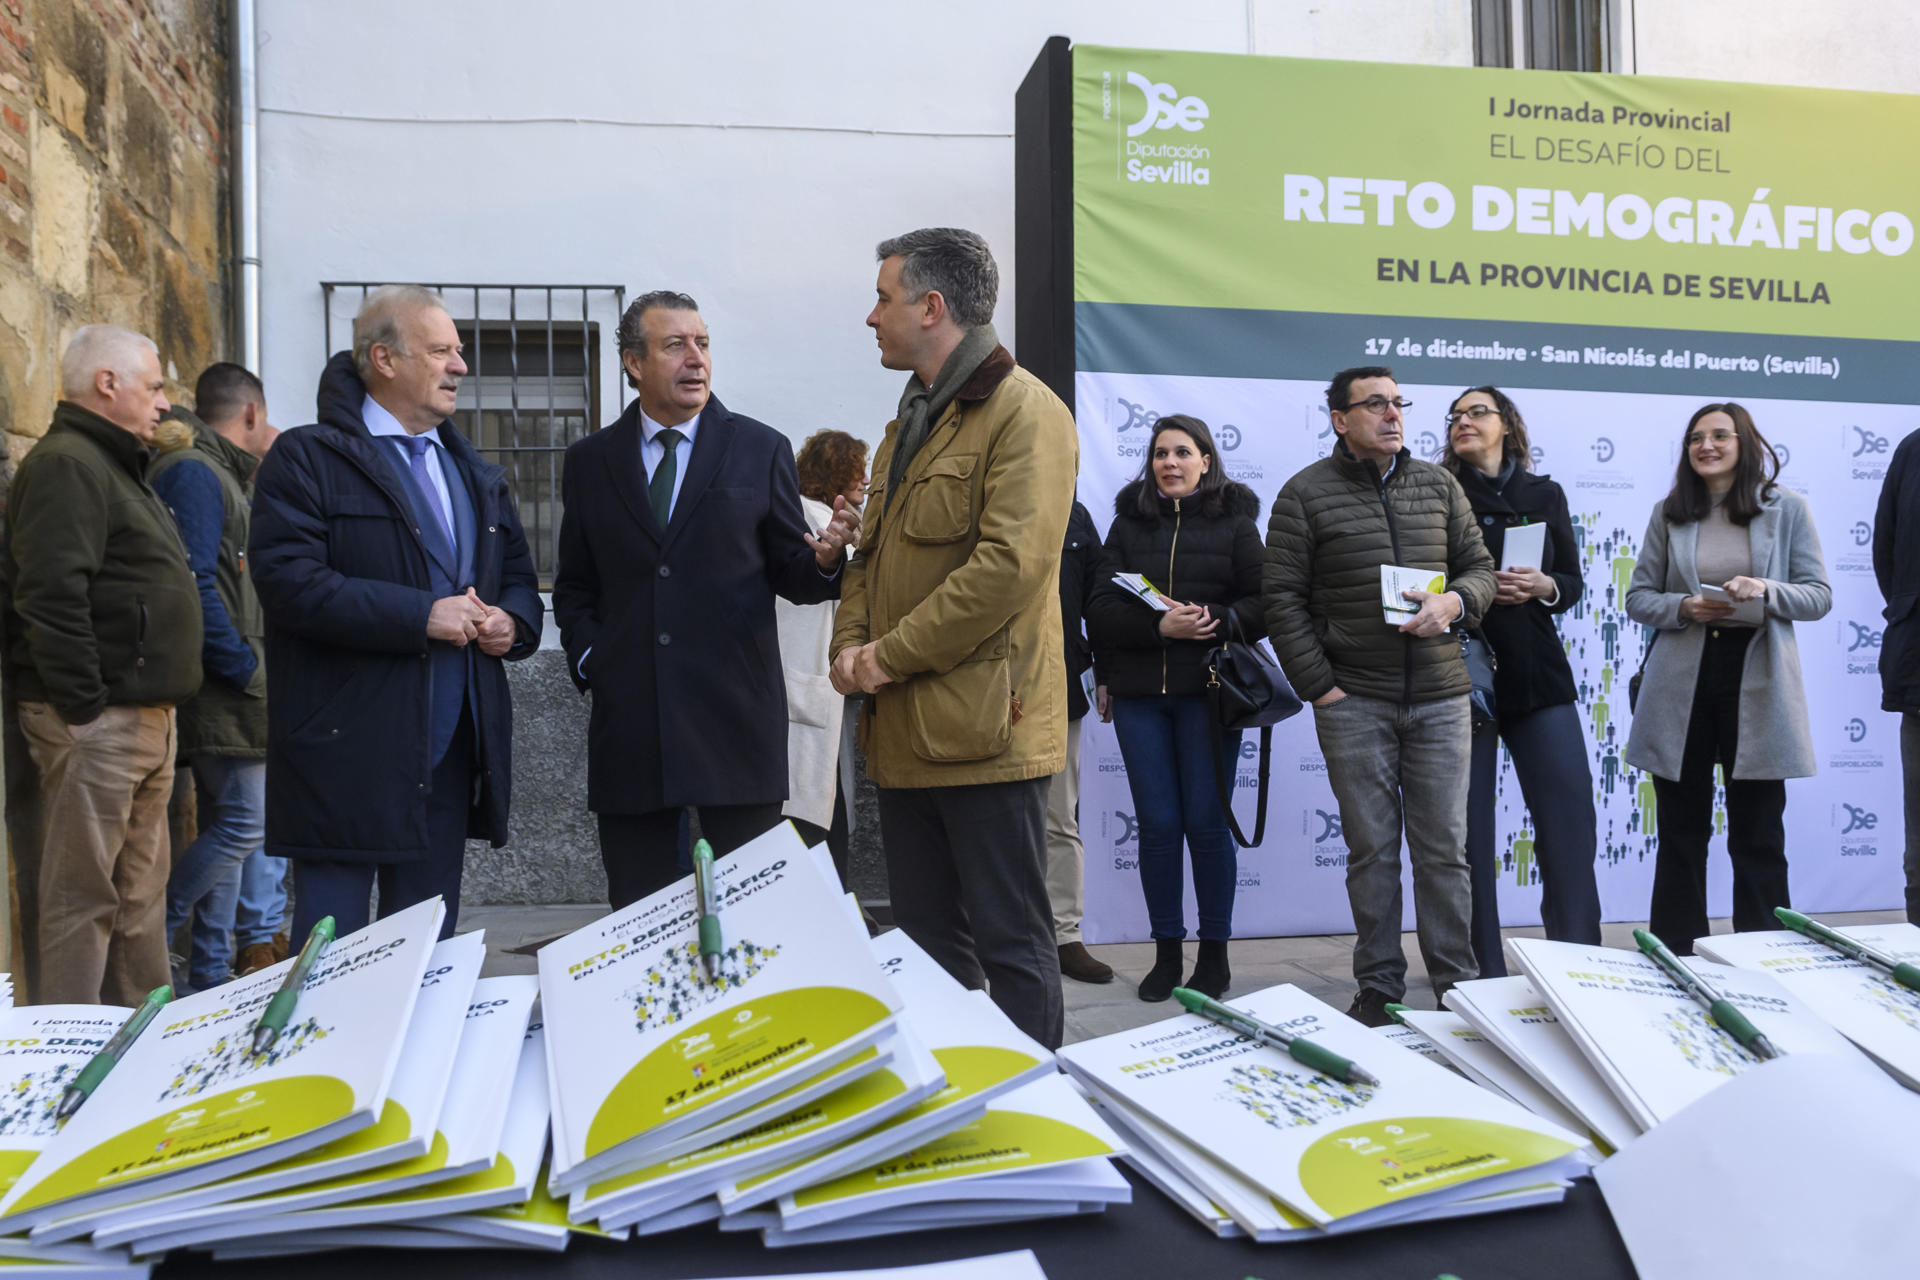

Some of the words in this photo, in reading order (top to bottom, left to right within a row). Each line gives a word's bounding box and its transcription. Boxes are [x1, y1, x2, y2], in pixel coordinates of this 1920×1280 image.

[1489, 97, 1495, 116] I
[1503, 98, 1604, 125] Jornada
[1612, 106, 1731, 133] Provincial
[1127, 140, 1210, 159] Diputación
[1490, 134, 1526, 159] EL
[1535, 136, 1666, 169] DESAFÍO
[1675, 146, 1731, 174] DEL
[1127, 158, 1210, 185] Sevilla
[1284, 173, 1456, 229] RETO
[1472, 185, 1915, 256] DEMOGRÁFICO
[1377, 257, 1419, 282] EN
[1429, 260, 1471, 285] LA
[1480, 262, 1654, 294] PROVINCIA
[1663, 273, 1701, 297] DE
[1709, 276, 1831, 304] SEVILLA
[1365, 337, 1393, 355] 17
[1396, 336, 1423, 357] de
[1426, 338, 1527, 362] diciembre
[1541, 345, 1580, 364] San
[1583, 346, 1657, 368] Nicolás
[1660, 349, 1690, 369] del
[1694, 353, 1760, 373] Puerto
[1763, 354, 1841, 380] (Sevilla)
[1835, 563, 1873, 572] DESPOBLA
[1848, 663, 1880, 675] Sevill
[1315, 855, 1349, 867] Sevill
[569, 943, 627, 974] RETO
[632, 859, 787, 946] DEMOÁFICO
[574, 968, 594, 981] EN
[598, 959, 617, 970] LA
[621, 918, 699, 960] PROVINCIA
[726, 873, 784, 907] SEVILLA
[610, 902, 667, 934] Jornada
[329, 951, 393, 981] SEVILLA
[1760, 956, 1811, 968] RETO
[1567, 971, 1625, 984] RETO
[42, 1018, 113, 1027] Jornada
[165, 1008, 230, 1032] RETO
[1508, 1006, 1550, 1017] RET
[1140, 1030, 1193, 1048] Jornada
[692, 1079, 715, 1093] de
[719, 1037, 807, 1082] diciembre
[1119, 1056, 1176, 1073] RETO
[1135, 1071, 1156, 1079] EN
[1157, 1066, 1177, 1074] LA
[1177, 1047, 1253, 1071] PROVINCIA
[931, 1146, 1022, 1166] diciembre
